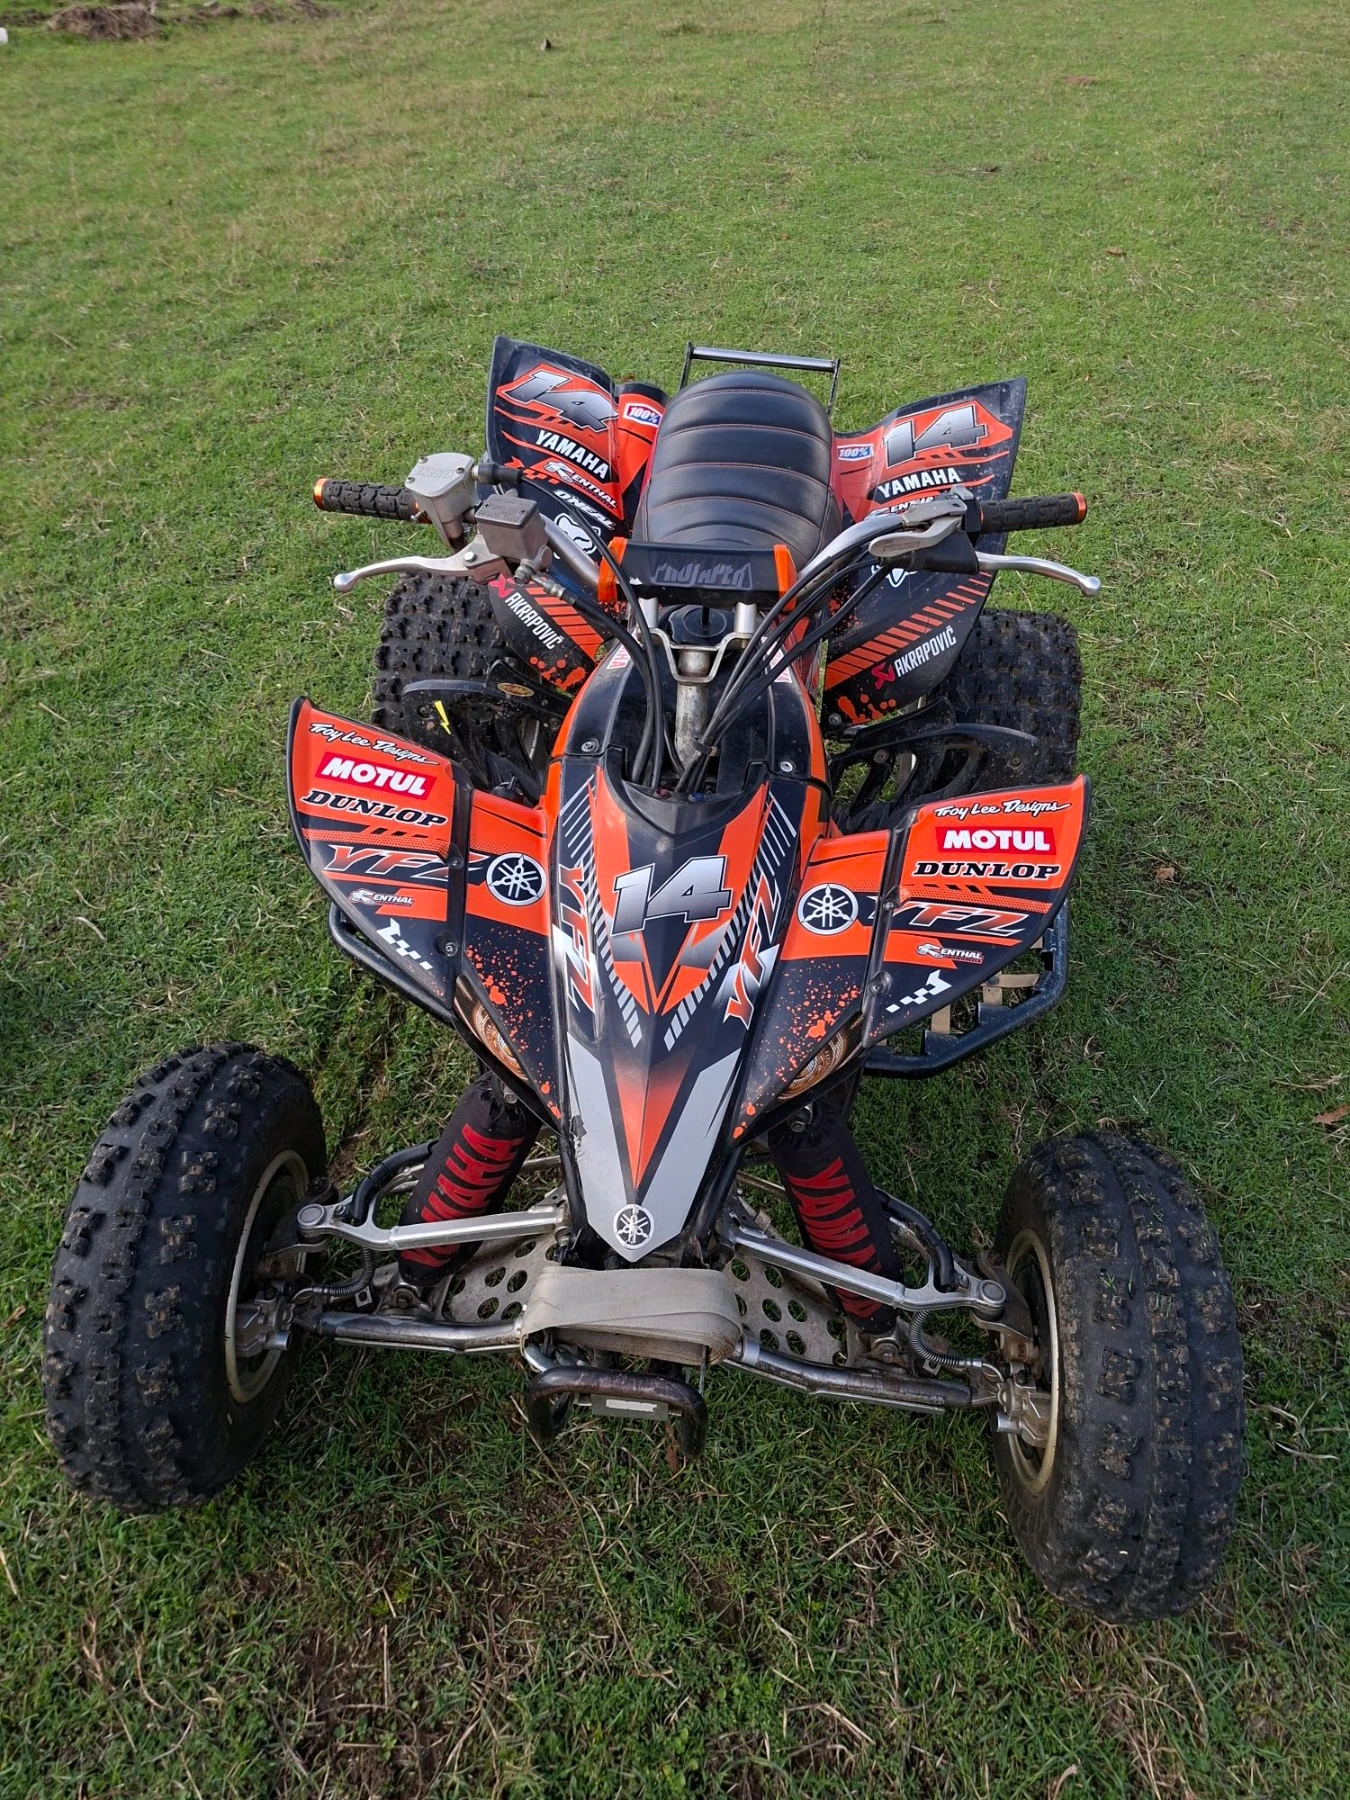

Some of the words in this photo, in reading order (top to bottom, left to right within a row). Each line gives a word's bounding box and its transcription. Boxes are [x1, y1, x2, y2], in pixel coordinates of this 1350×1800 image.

[504, 369, 619, 433] 14
[628, 406, 659, 424] 100%
[535, 430, 610, 480] YAMAHA
[839, 446, 869, 458] 100%
[882, 403, 987, 469] 14
[877, 467, 962, 499] YAMAHA
[310, 723, 342, 742] Troy
[341, 732, 372, 747] Lee
[371, 739, 440, 766] Designs
[320, 757, 427, 796] MOTUL
[301, 788, 448, 828] DUNLOP
[934, 804, 969, 821] Troy
[970, 803, 1001, 815] Lee
[1001, 799, 1072, 817] Designs
[943, 829, 1051, 852] MOTUL
[323, 844, 491, 882] YFZ
[911, 861, 1062, 881] DUNLOP
[610, 854, 732, 936] 14
[558, 862, 597, 1015] YFZ
[723, 872, 781, 1031] YFZ
[401, 1123, 525, 1268] YMAHA
[786, 1156, 882, 1318] YAMAA
